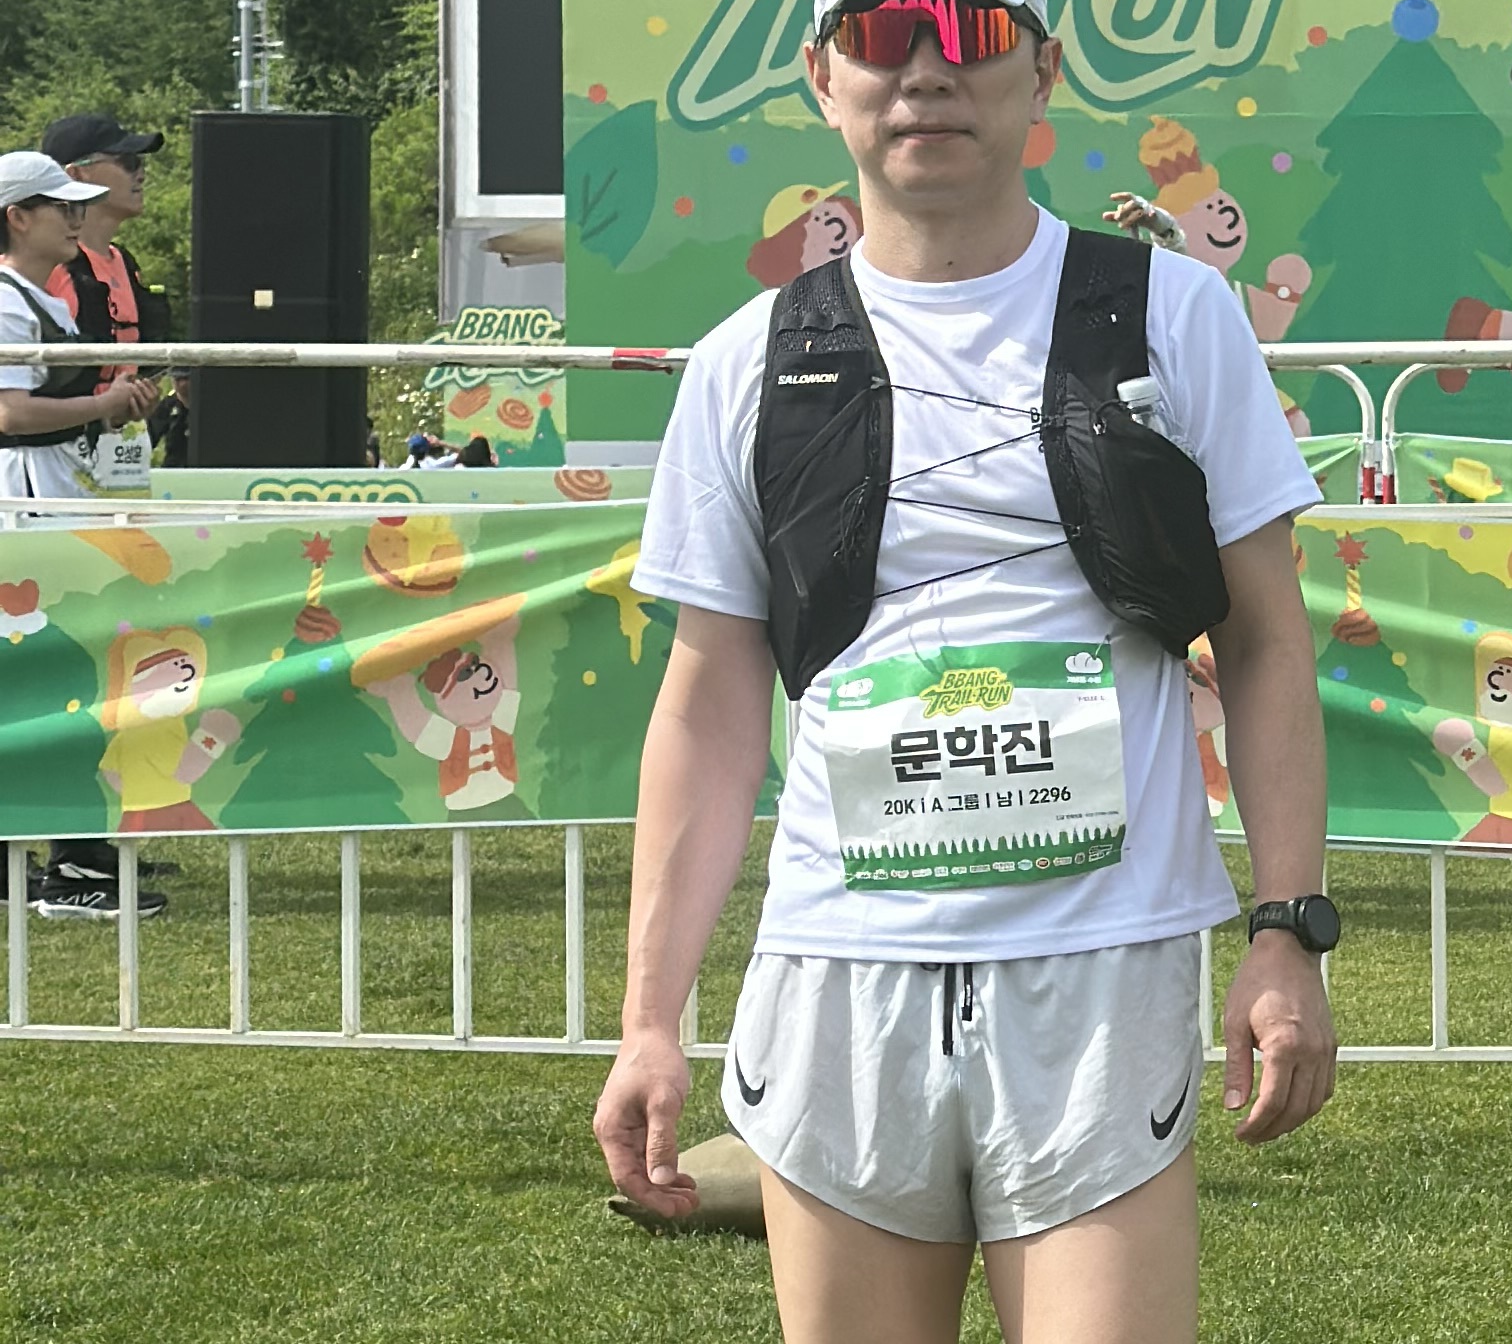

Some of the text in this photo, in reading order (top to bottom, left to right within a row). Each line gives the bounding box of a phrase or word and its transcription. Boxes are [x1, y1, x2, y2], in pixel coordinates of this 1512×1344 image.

[457, 312, 554, 340] BBANG
[777, 372, 839, 385] SALOMON
[943, 670, 999, 690] BBANG
[891, 720, 1054, 783] 문학진
[884, 798, 917, 816] 20K
[930, 797, 944, 813] A
[947, 793, 980, 812] 그룹
[997, 791, 1013, 808] 남
[1028, 786, 1072, 805] 2296
